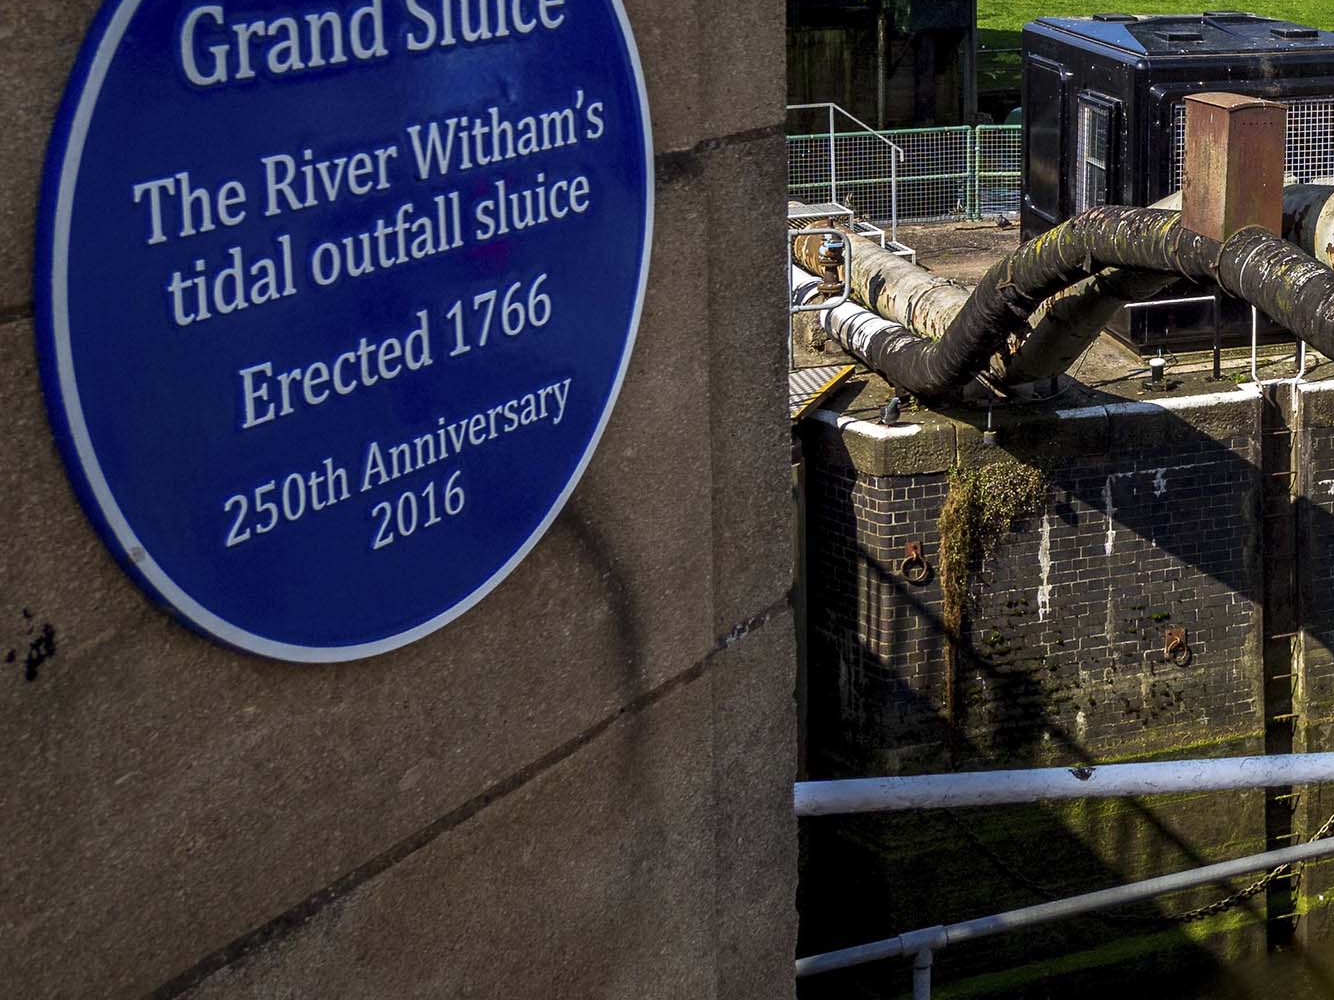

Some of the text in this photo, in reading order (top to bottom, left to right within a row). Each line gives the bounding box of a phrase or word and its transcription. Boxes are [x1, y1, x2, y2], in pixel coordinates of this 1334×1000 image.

[133, 87, 605, 245] The River Witham's
[167, 174, 591, 327] tidal outfall sluice
[239, 273, 553, 429] Erected 1766
[224, 378, 573, 547] 250th Anniversary
[371, 469, 466, 550] 2016
